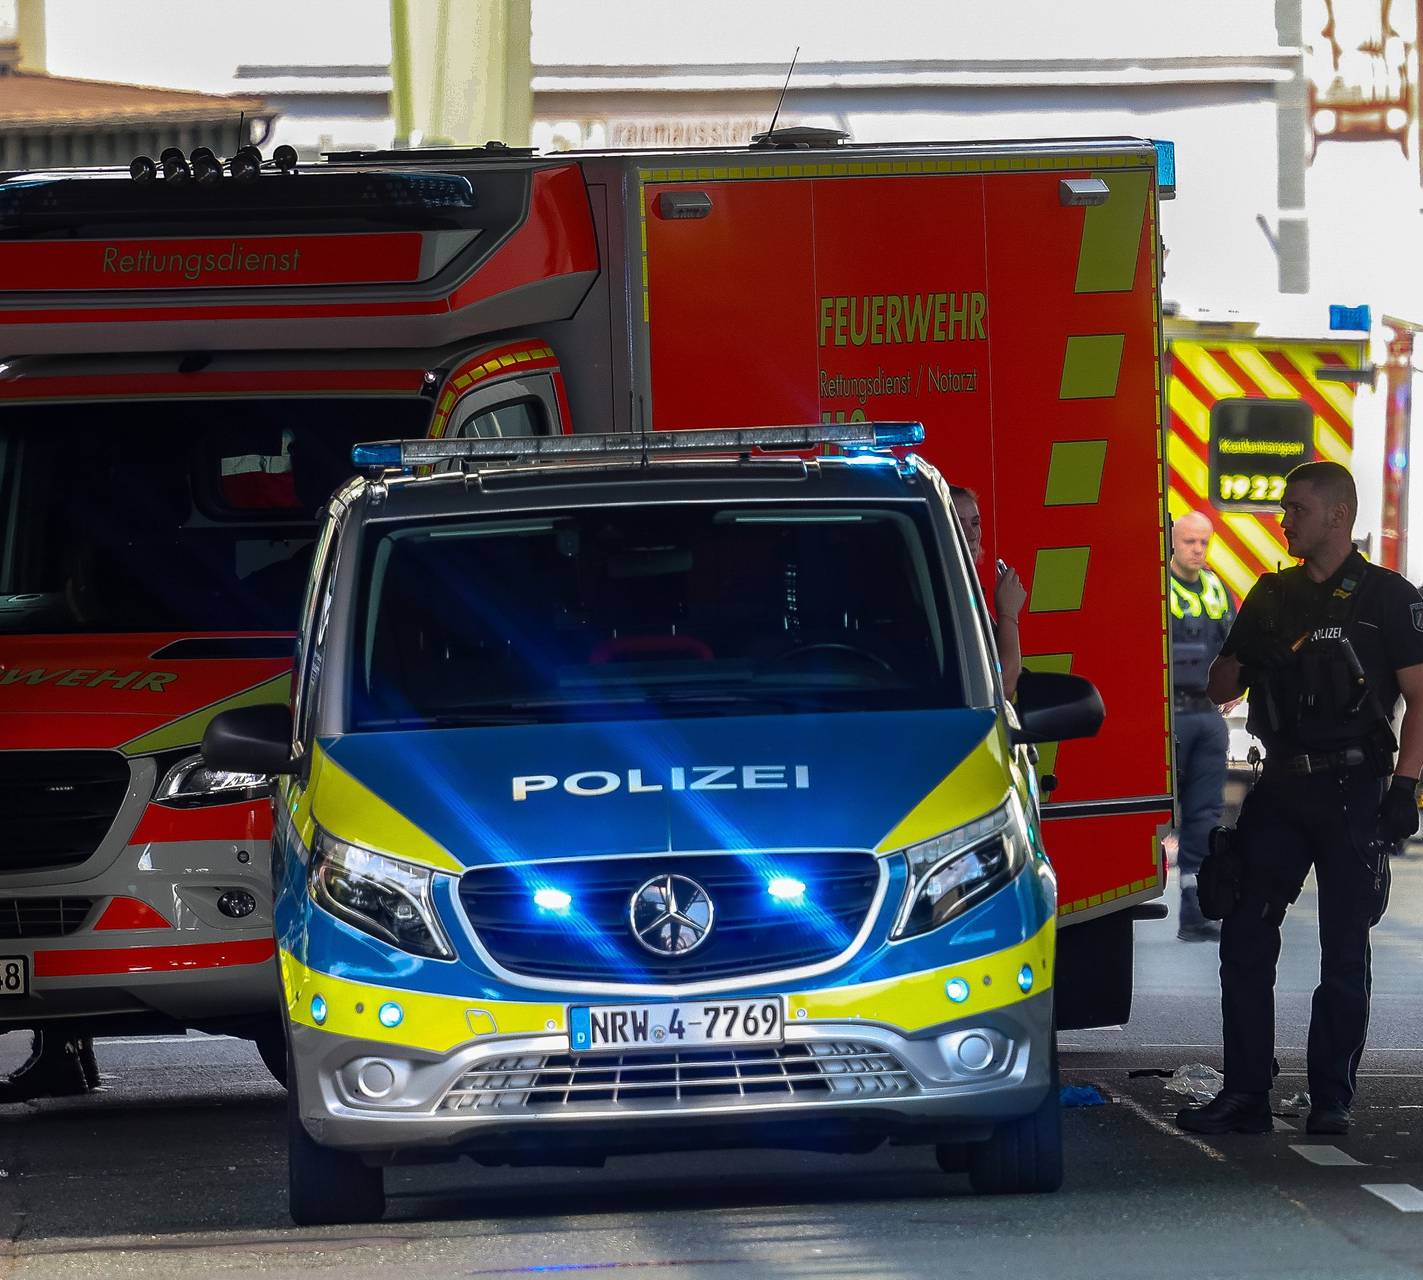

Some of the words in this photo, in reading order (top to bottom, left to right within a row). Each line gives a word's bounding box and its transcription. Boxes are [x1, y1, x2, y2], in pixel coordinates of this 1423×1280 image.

[103, 242, 301, 280] Rettungsdienst
[819, 292, 988, 347] FEUERWEHR
[820, 366, 911, 404] Rettungsdienst
[928, 365, 977, 393] Notarzt
[1219, 474, 1287, 500] 1922
[512, 765, 809, 801] POLIZEI
[0, 962, 20, 990] 8
[577, 1032, 585, 1043] D
[591, 1009, 649, 1043] NRW
